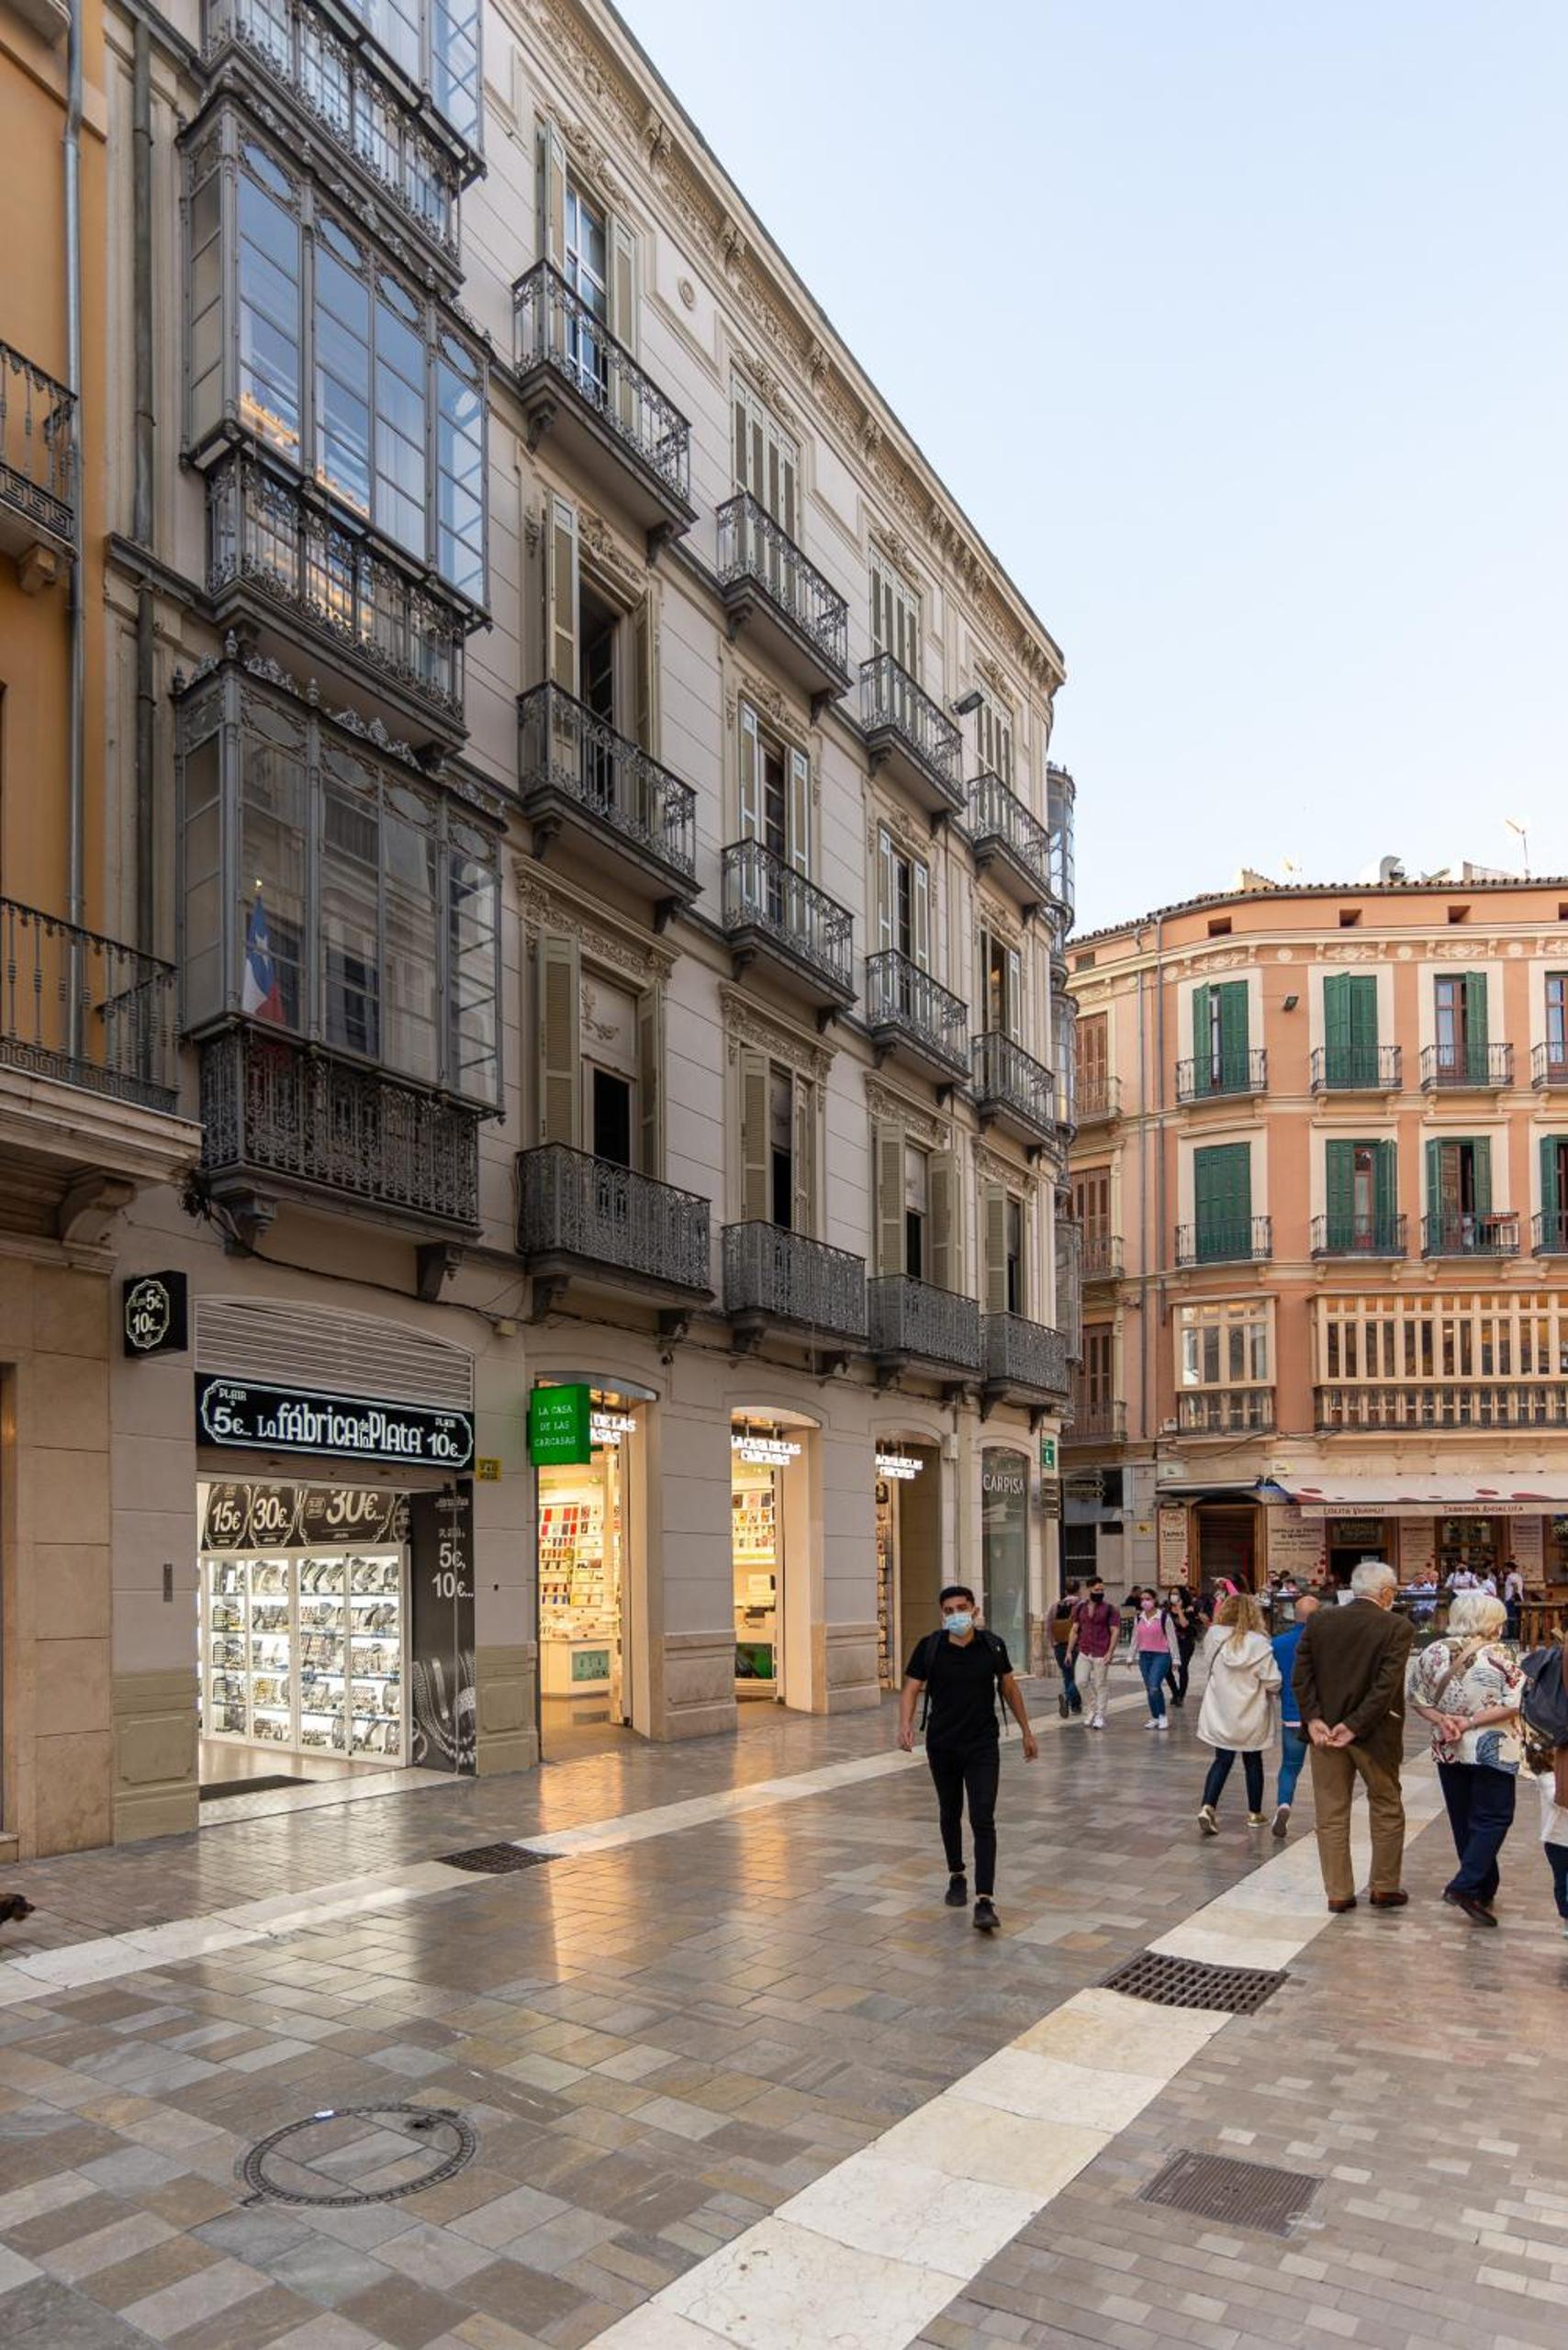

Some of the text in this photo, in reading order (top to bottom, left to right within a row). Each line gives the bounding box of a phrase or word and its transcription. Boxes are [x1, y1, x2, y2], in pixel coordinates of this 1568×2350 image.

[538, 1404, 573, 1416] LA CASA
[539, 1420, 570, 1432] DE LAS
[533, 1436, 576, 1448] CARCASAS
[982, 1473, 1026, 1494] CARPISA
